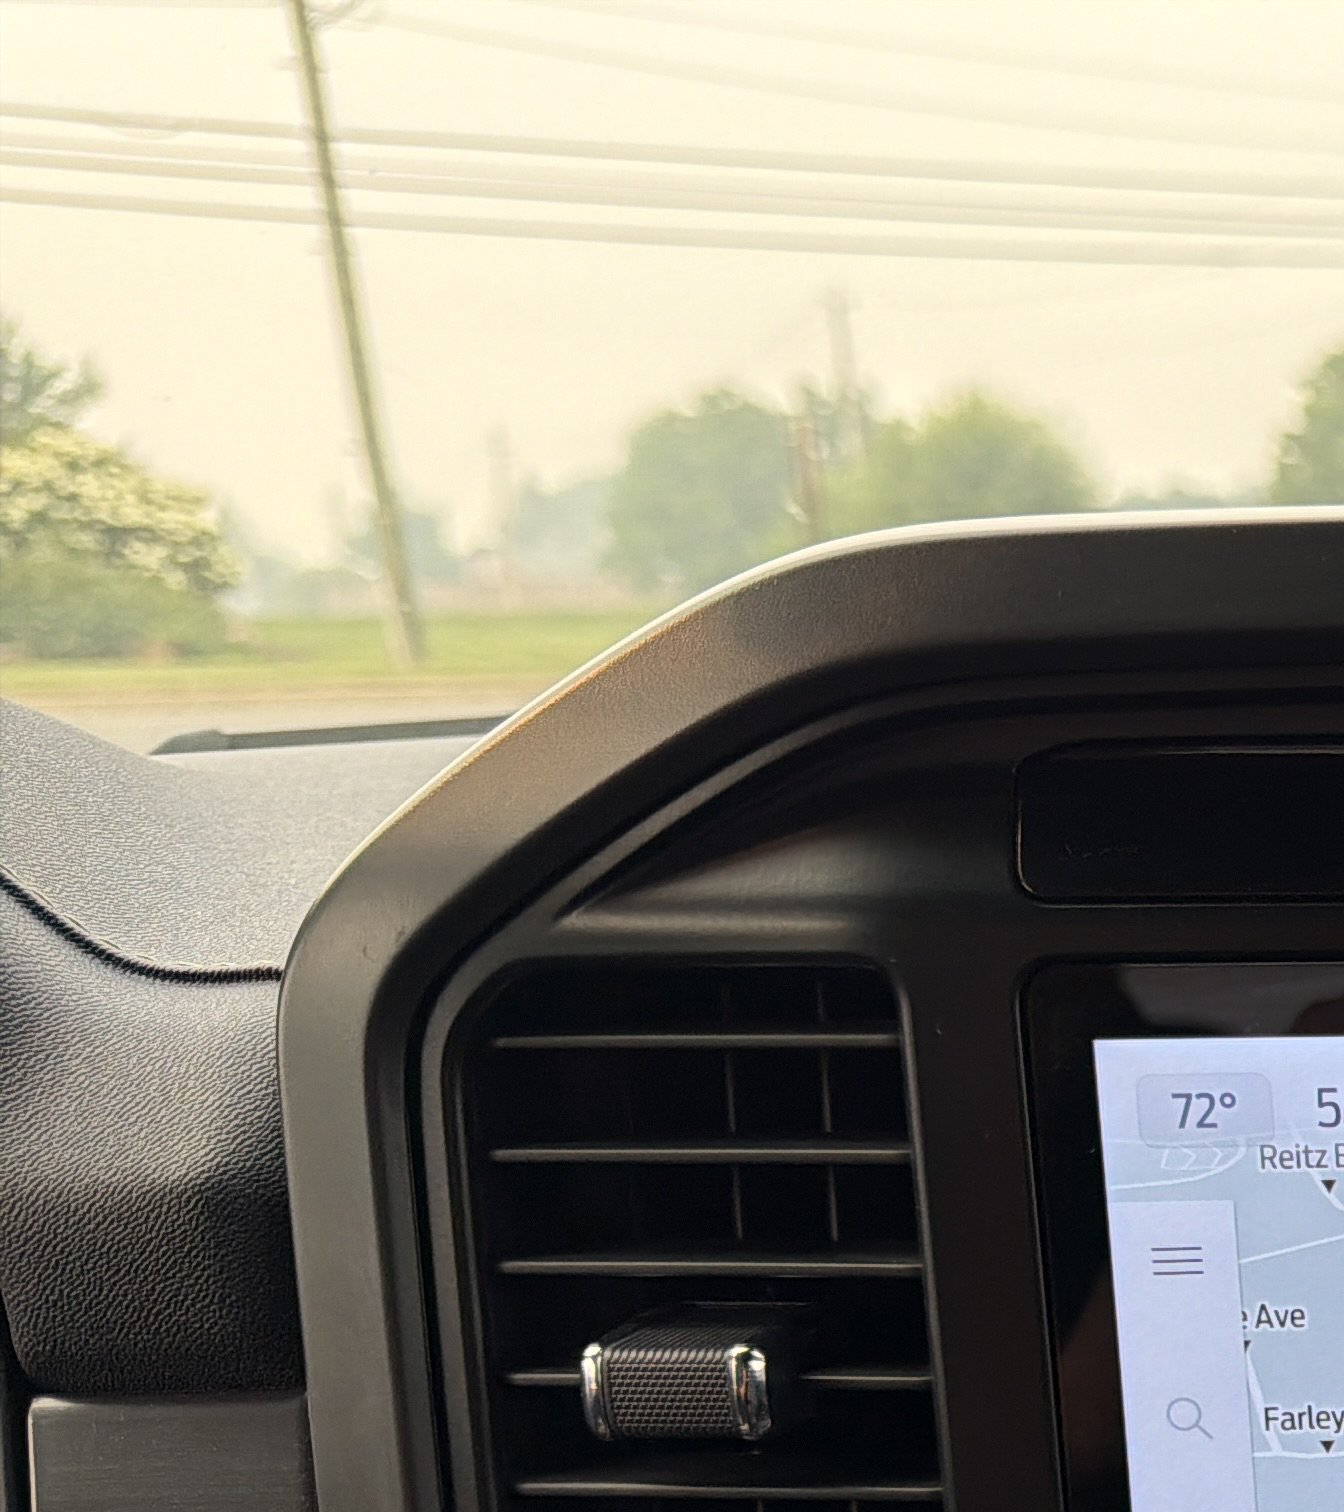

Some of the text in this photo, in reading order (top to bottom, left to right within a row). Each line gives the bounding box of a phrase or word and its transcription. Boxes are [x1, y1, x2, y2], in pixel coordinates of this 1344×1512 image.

[1171, 1092, 1237, 1129] 72°
[1259, 1143, 1329, 1170] Reitz
[1255, 1303, 1306, 1329] Ave
